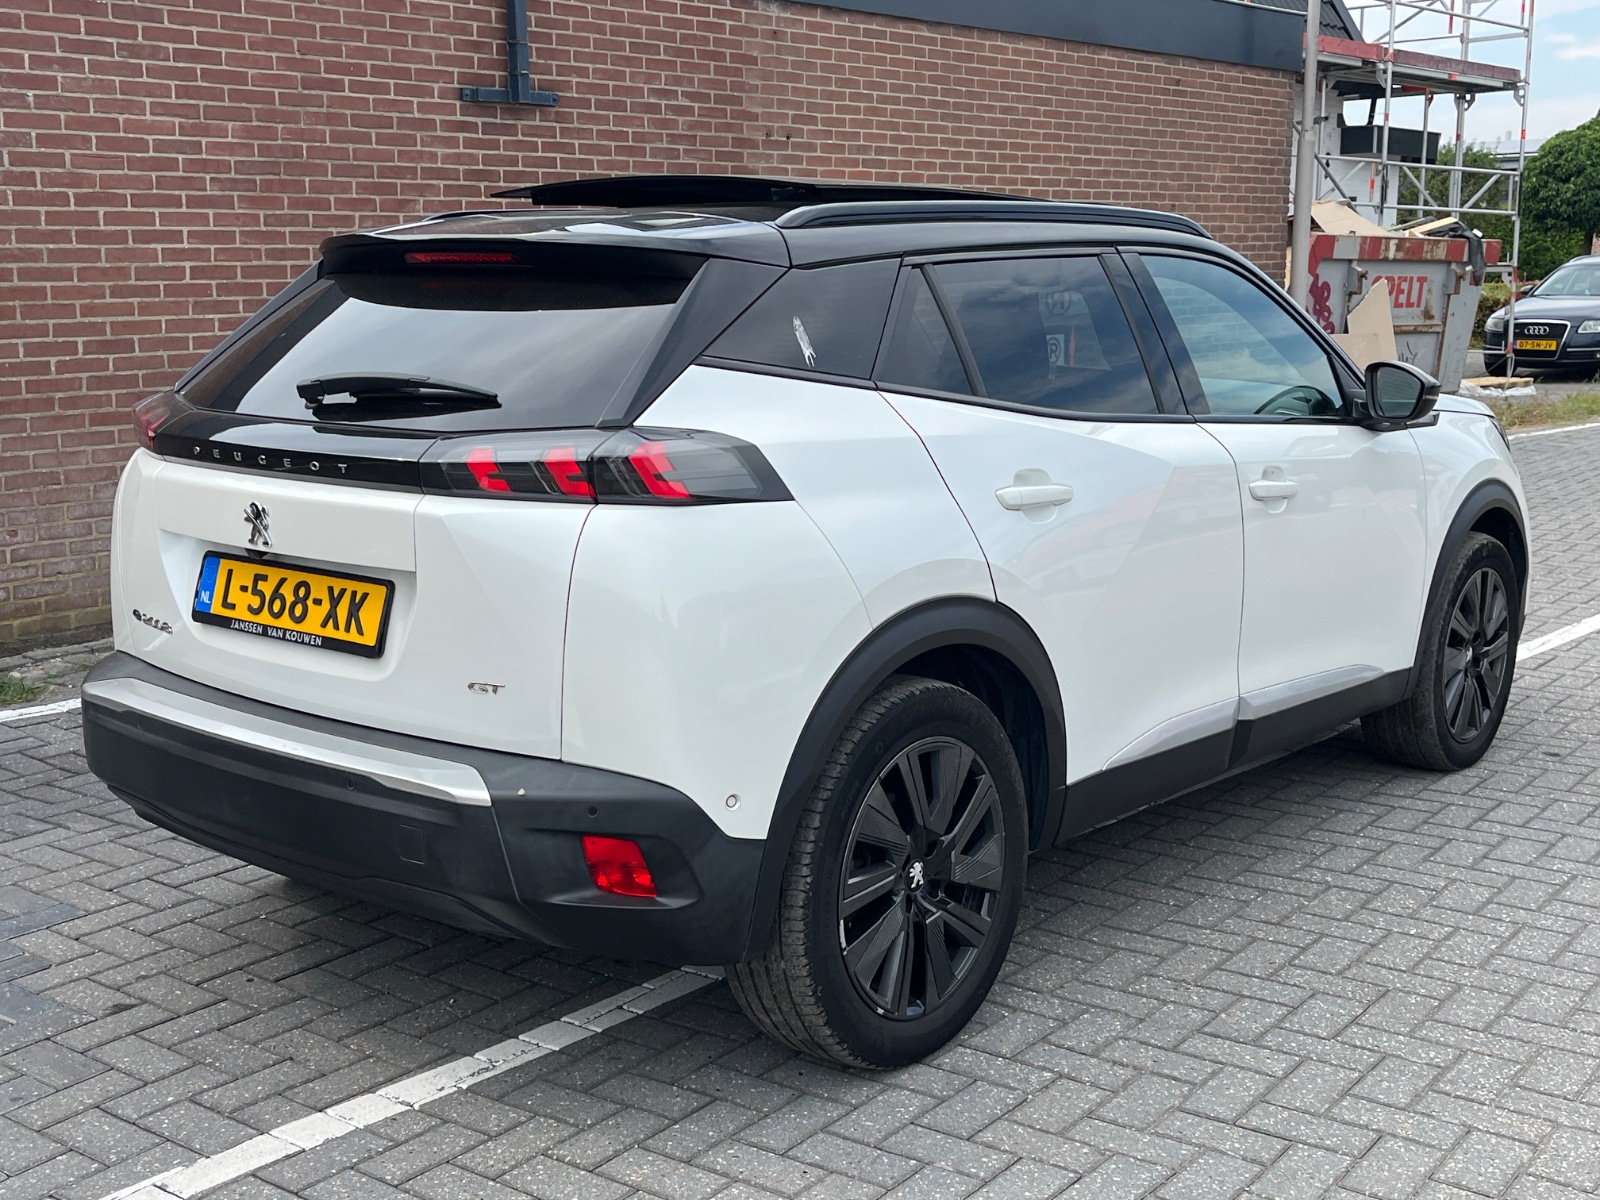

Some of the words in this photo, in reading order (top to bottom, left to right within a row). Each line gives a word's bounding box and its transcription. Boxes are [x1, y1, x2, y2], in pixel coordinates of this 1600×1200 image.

[1371, 275, 1428, 308] PELT
[1518, 340, 1554, 349] 07-SN-JV
[193, 446, 348, 474] PEUGEOT
[200, 590, 212, 604] NL
[221, 568, 370, 636] L-568-XK
[230, 619, 263, 635] JANSSEN
[267, 626, 284, 639] VAN
[285, 630, 322, 646] KOUWEN
[467, 681, 505, 695] GT
